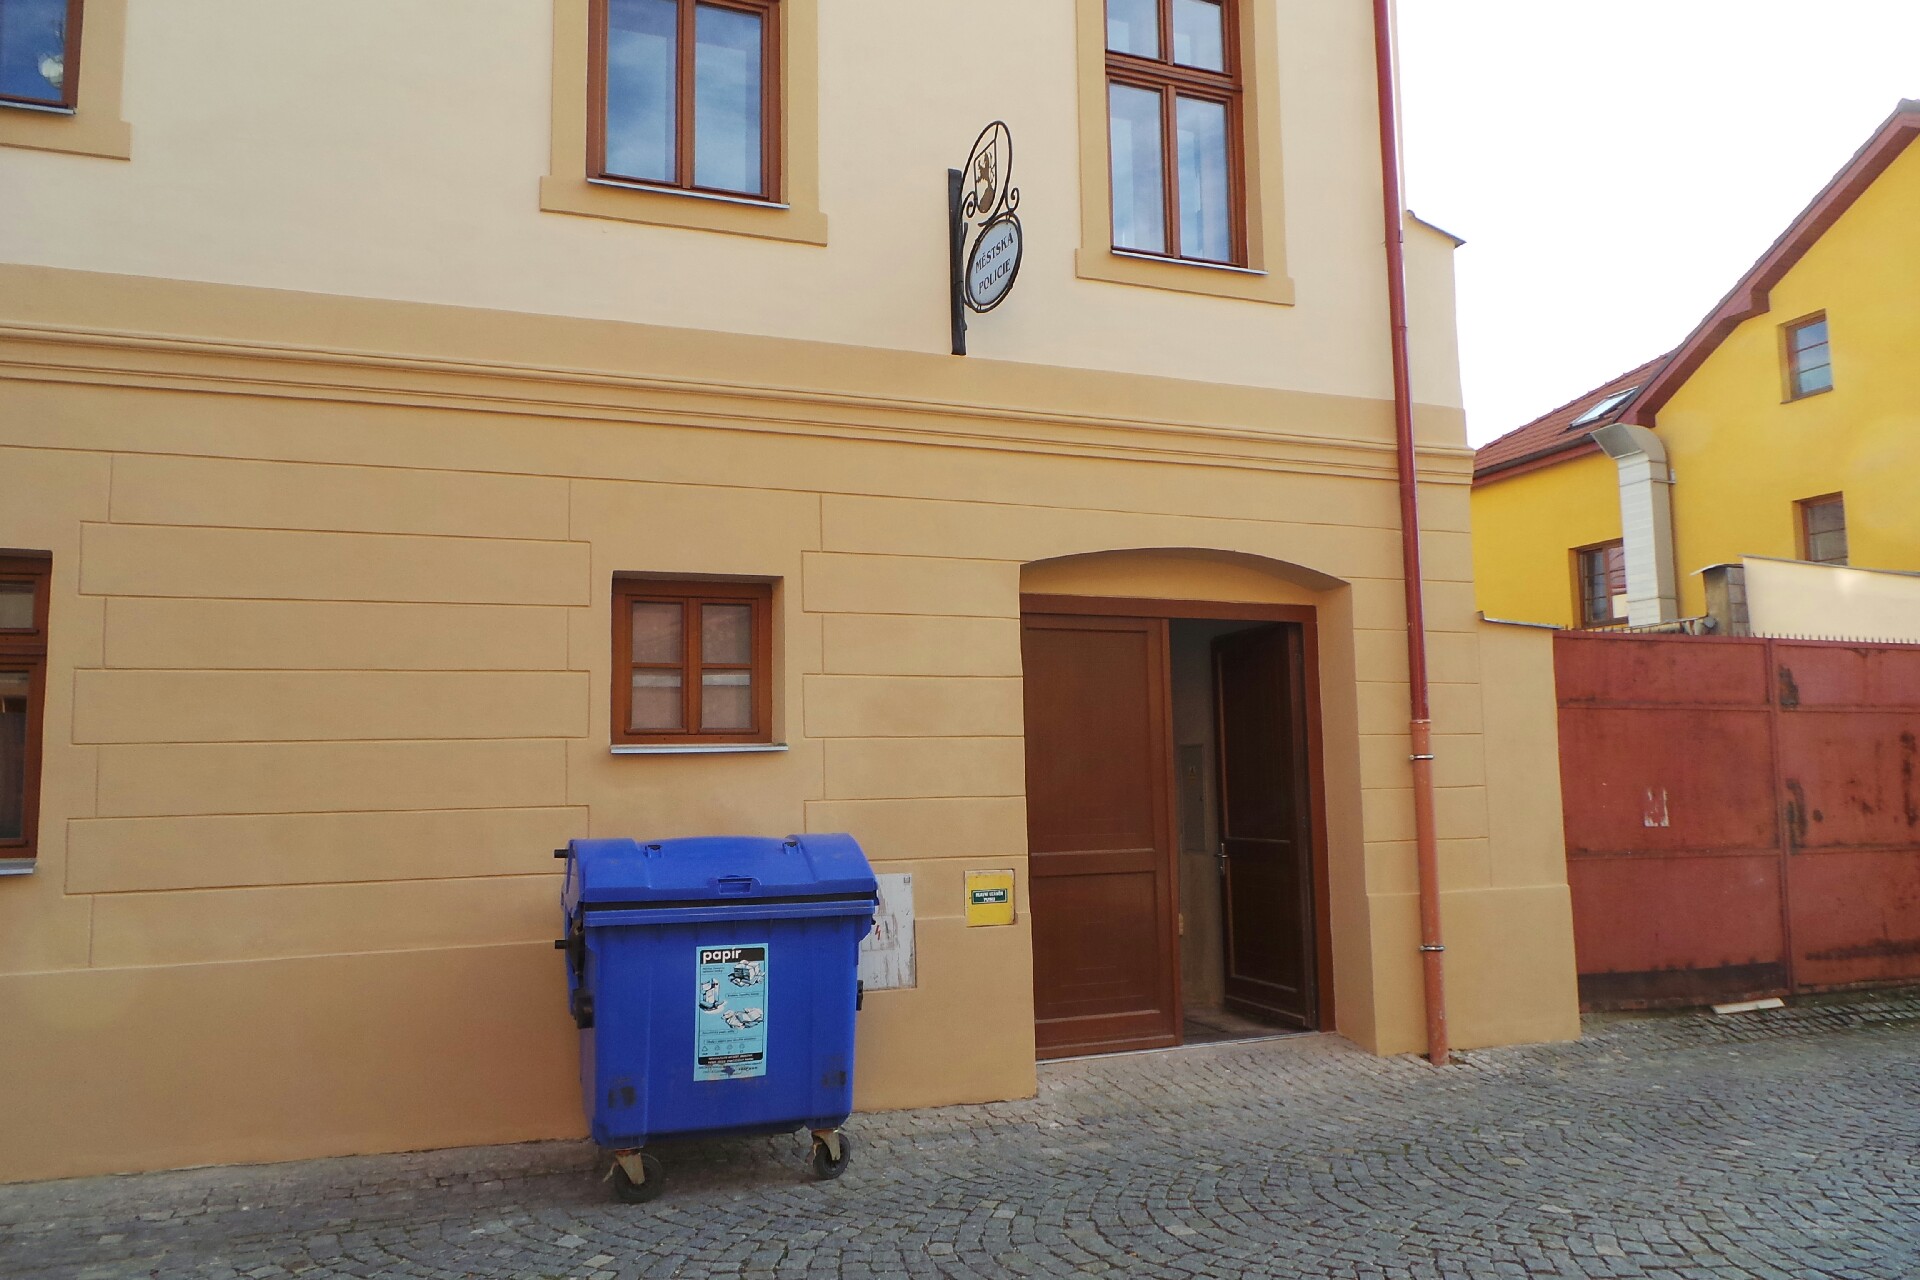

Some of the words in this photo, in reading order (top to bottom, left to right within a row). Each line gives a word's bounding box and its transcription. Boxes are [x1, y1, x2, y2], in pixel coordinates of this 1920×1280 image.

[975, 228, 1014, 274] MĚSTSKÁ
[978, 258, 1011, 295] POLICIE
[703, 948, 742, 964] papír
